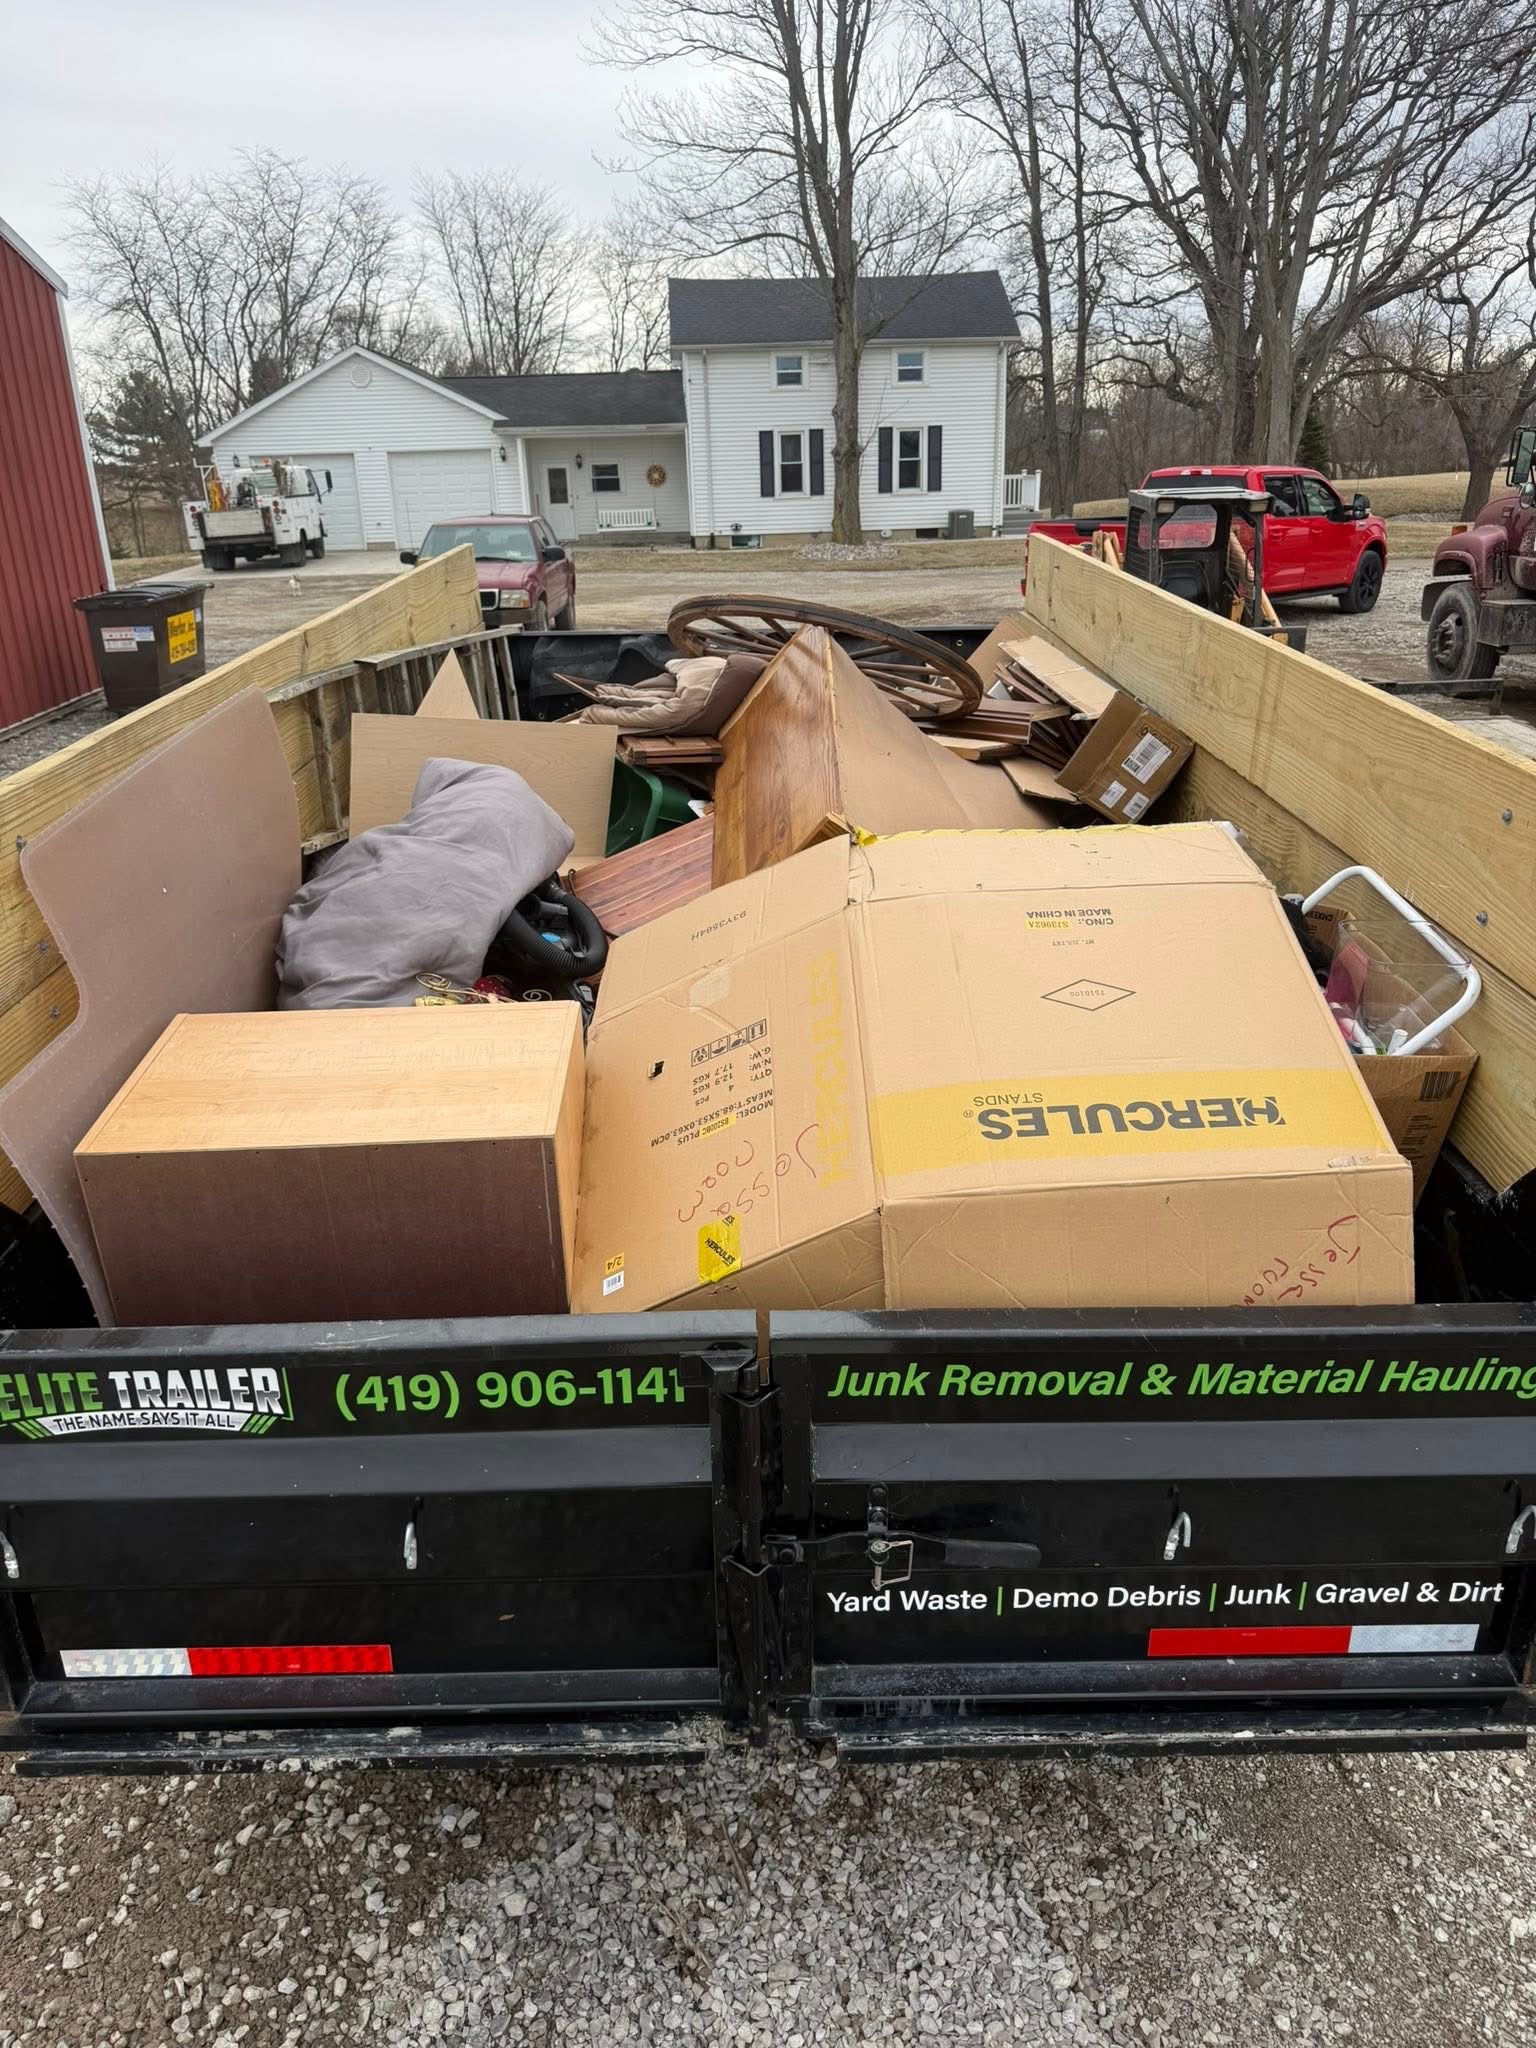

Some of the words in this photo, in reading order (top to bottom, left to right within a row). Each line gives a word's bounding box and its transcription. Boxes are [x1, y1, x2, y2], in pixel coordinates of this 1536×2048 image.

[1026, 910, 1062, 919] CHINA
[1078, 908, 1112, 916] MADE
[714, 1062, 733, 1076] 17.7
[750, 1068, 773, 1081] QTY:
[810, 951, 846, 1190] HERCULES
[692, 1072, 710, 1086] KGS
[714, 1072, 733, 1086] 12.9
[692, 1082, 710, 1096] KGS
[728, 1084, 734, 1092] 4
[695, 1095, 710, 1107] PCS
[973, 1092, 1044, 1107] STANDS
[735, 1099, 774, 1119] MODEL:
[976, 1095, 1287, 1141] HERCULES
[677, 1129, 700, 1146] PLUS
[703, 1237, 736, 1266] HERCULES
[828, 1363, 931, 1398] Junk
[939, 1362, 1134, 1397] Removal
[1140, 1363, 1177, 1396] &
[1189, 1359, 1373, 1396] Material
[1378, 1358, 1536, 1400] Hauling
[0, 1371, 103, 1422] ELITE
[108, 1367, 285, 1415] TRAILER
[335, 1370, 460, 1421] (419)
[476, 1367, 685, 1408] 906-1141
[53, 1416, 86, 1432] THE
[91, 1412, 136, 1430] NAME
[142, 1412, 180, 1427] SAYS
[185, 1412, 200, 1427] IT
[205, 1413, 236, 1428] ALL
[827, 1589, 895, 1614] Yard
[900, 1589, 988, 1612] Waste
[1013, 1587, 1098, 1609] Demo
[1108, 1584, 1201, 1608] Debris
[1224, 1583, 1291, 1606] Junk
[1315, 1581, 1407, 1605] Gravel
[1417, 1582, 1439, 1603] &
[1449, 1581, 1504, 1604] Dirt
